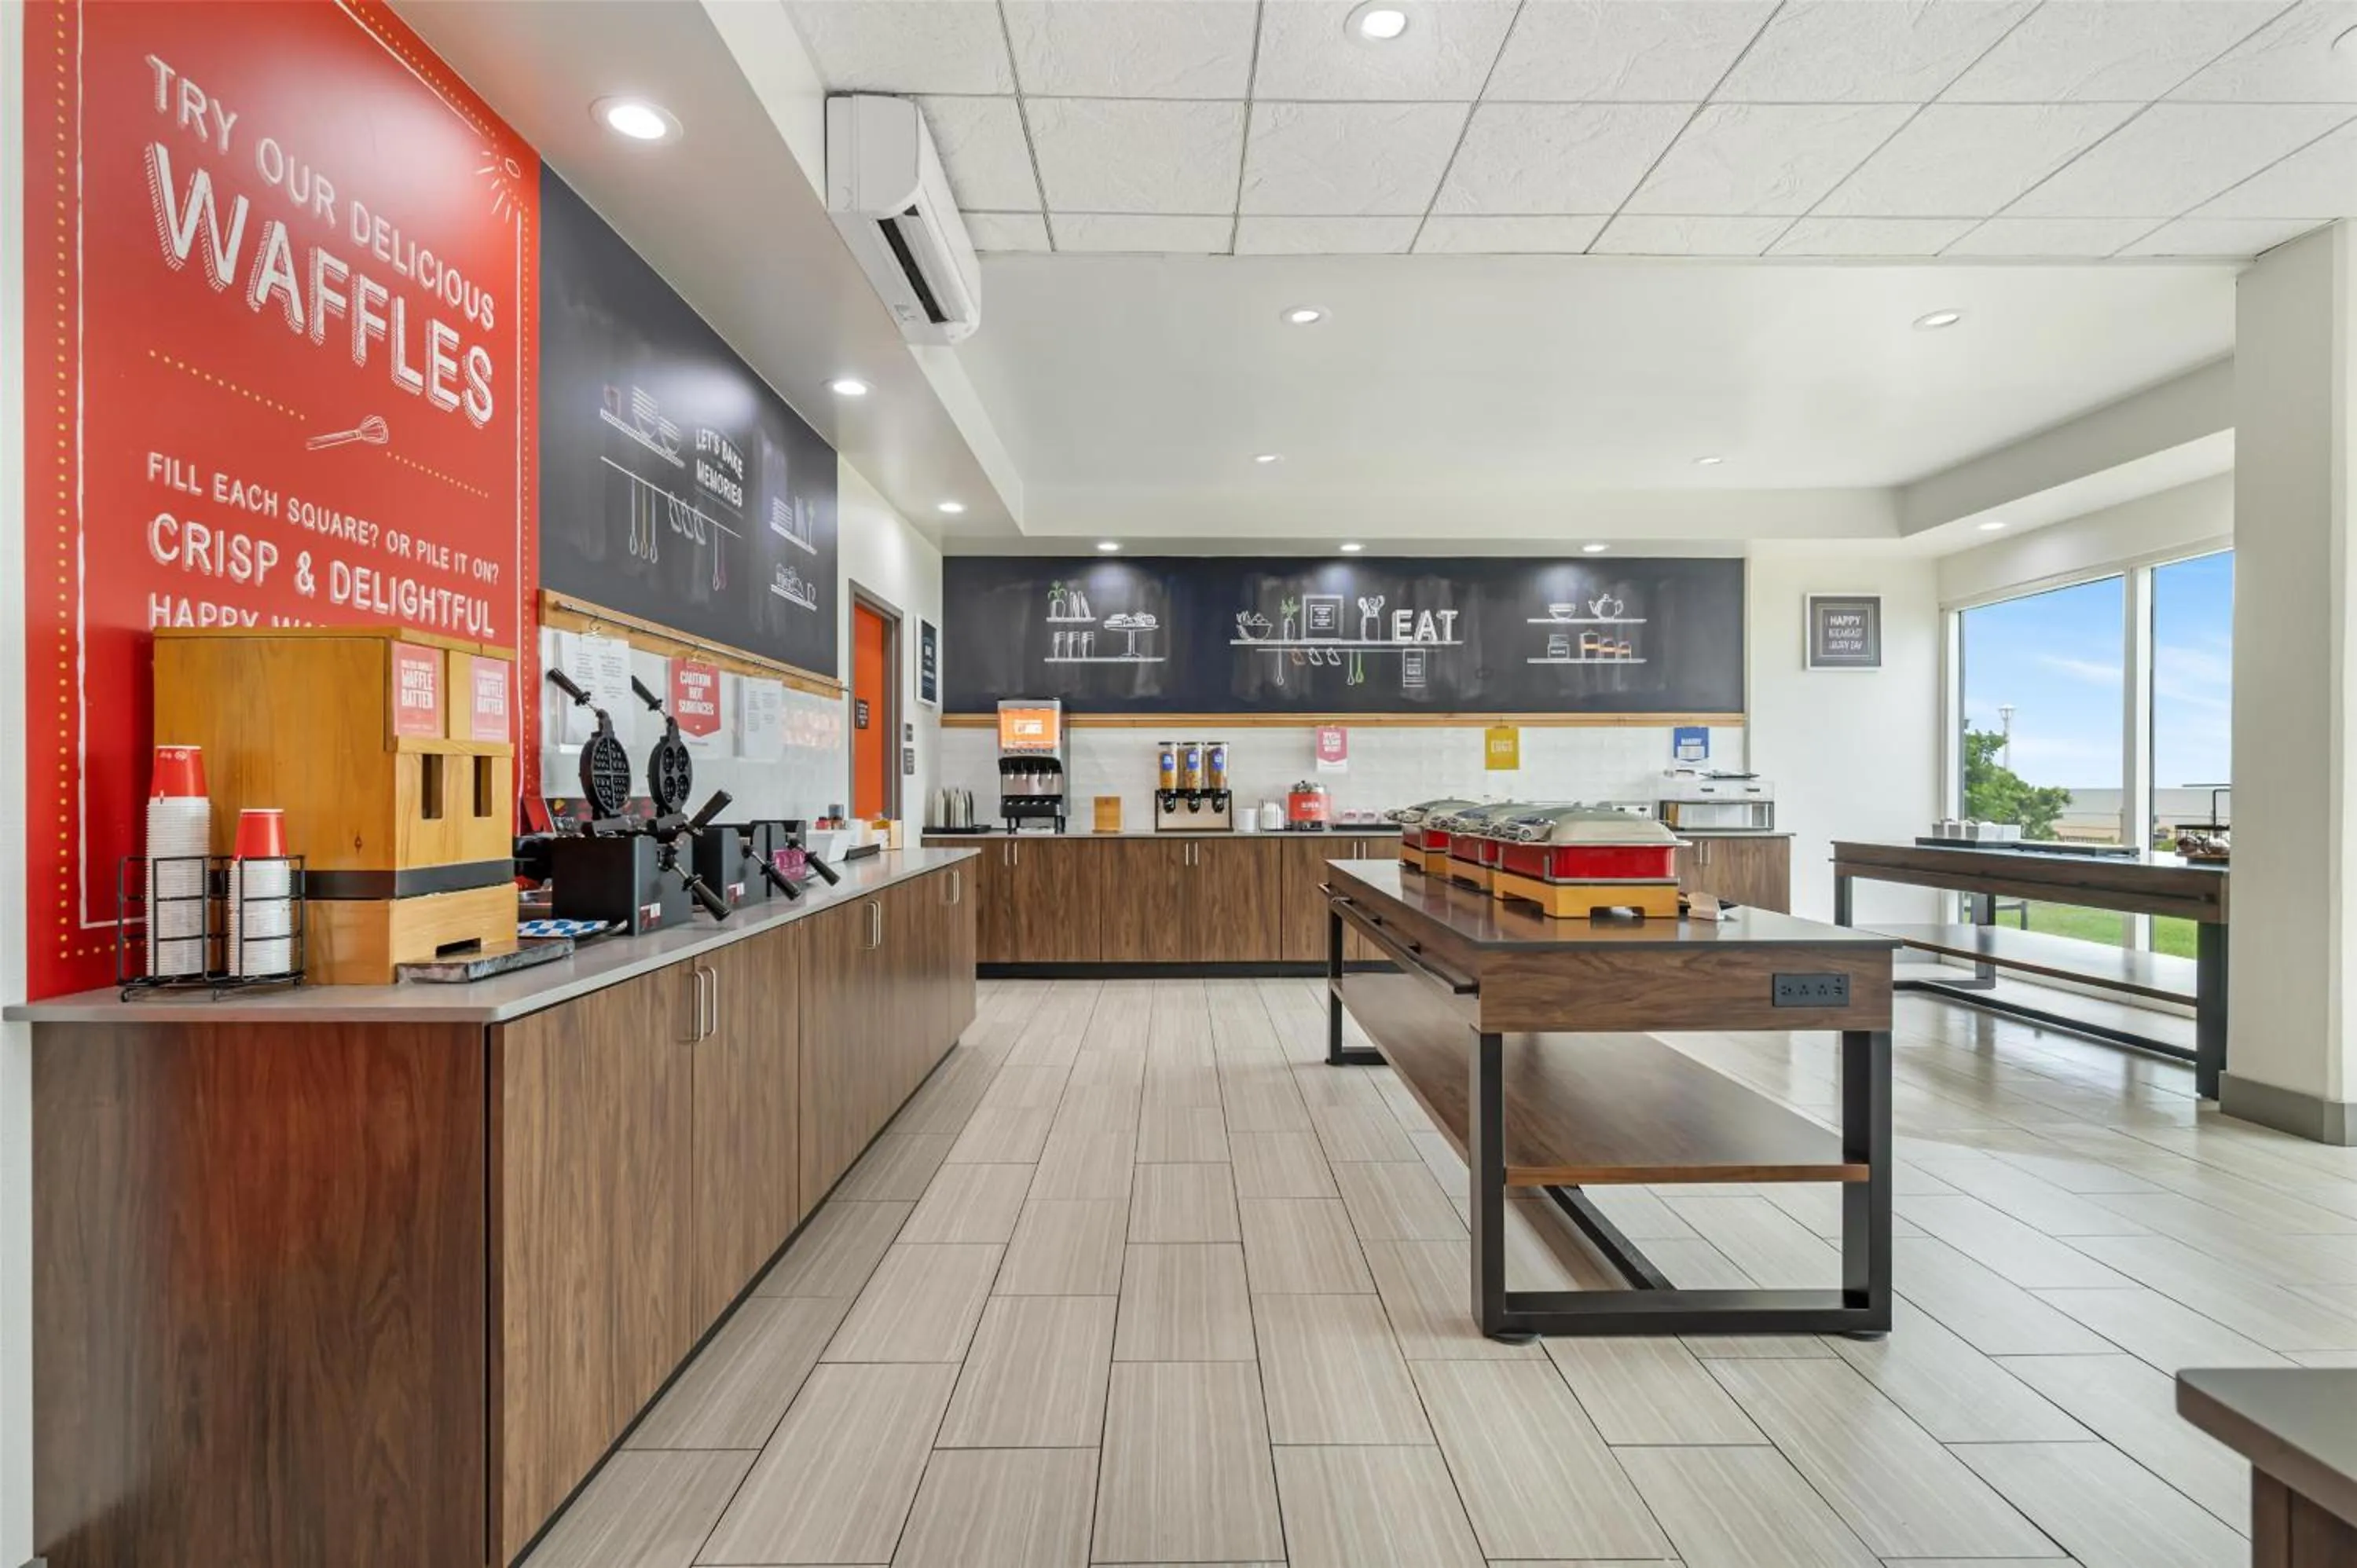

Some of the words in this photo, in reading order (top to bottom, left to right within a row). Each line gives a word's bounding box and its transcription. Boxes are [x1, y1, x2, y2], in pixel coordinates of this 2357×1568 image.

[146, 53, 238, 155] TRY
[255, 137, 336, 228] OUR
[350, 200, 494, 332] DELICIOUS
[145, 141, 493, 429] WAFFLES
[696, 427, 720, 455] LET'S
[722, 439, 742, 481] BAKE
[696, 458, 743, 508] MEMORIES
[147, 451, 203, 496] FILL
[213, 471, 278, 518] EACH
[287, 497, 379, 548] SQUARE?
[386, 529, 411, 559] OR
[416, 539, 449, 570] PILE
[454, 552, 468, 575] IT
[472, 557, 500, 586] ON?
[147, 512, 279, 587] CRISP
[294, 551, 316, 599] &
[329, 559, 496, 639] DELIGHTFUL
[1391, 609, 1459, 642] EAT
[1829, 615, 1861, 627] HAPPY
[401, 668, 434, 691] WAFFLE
